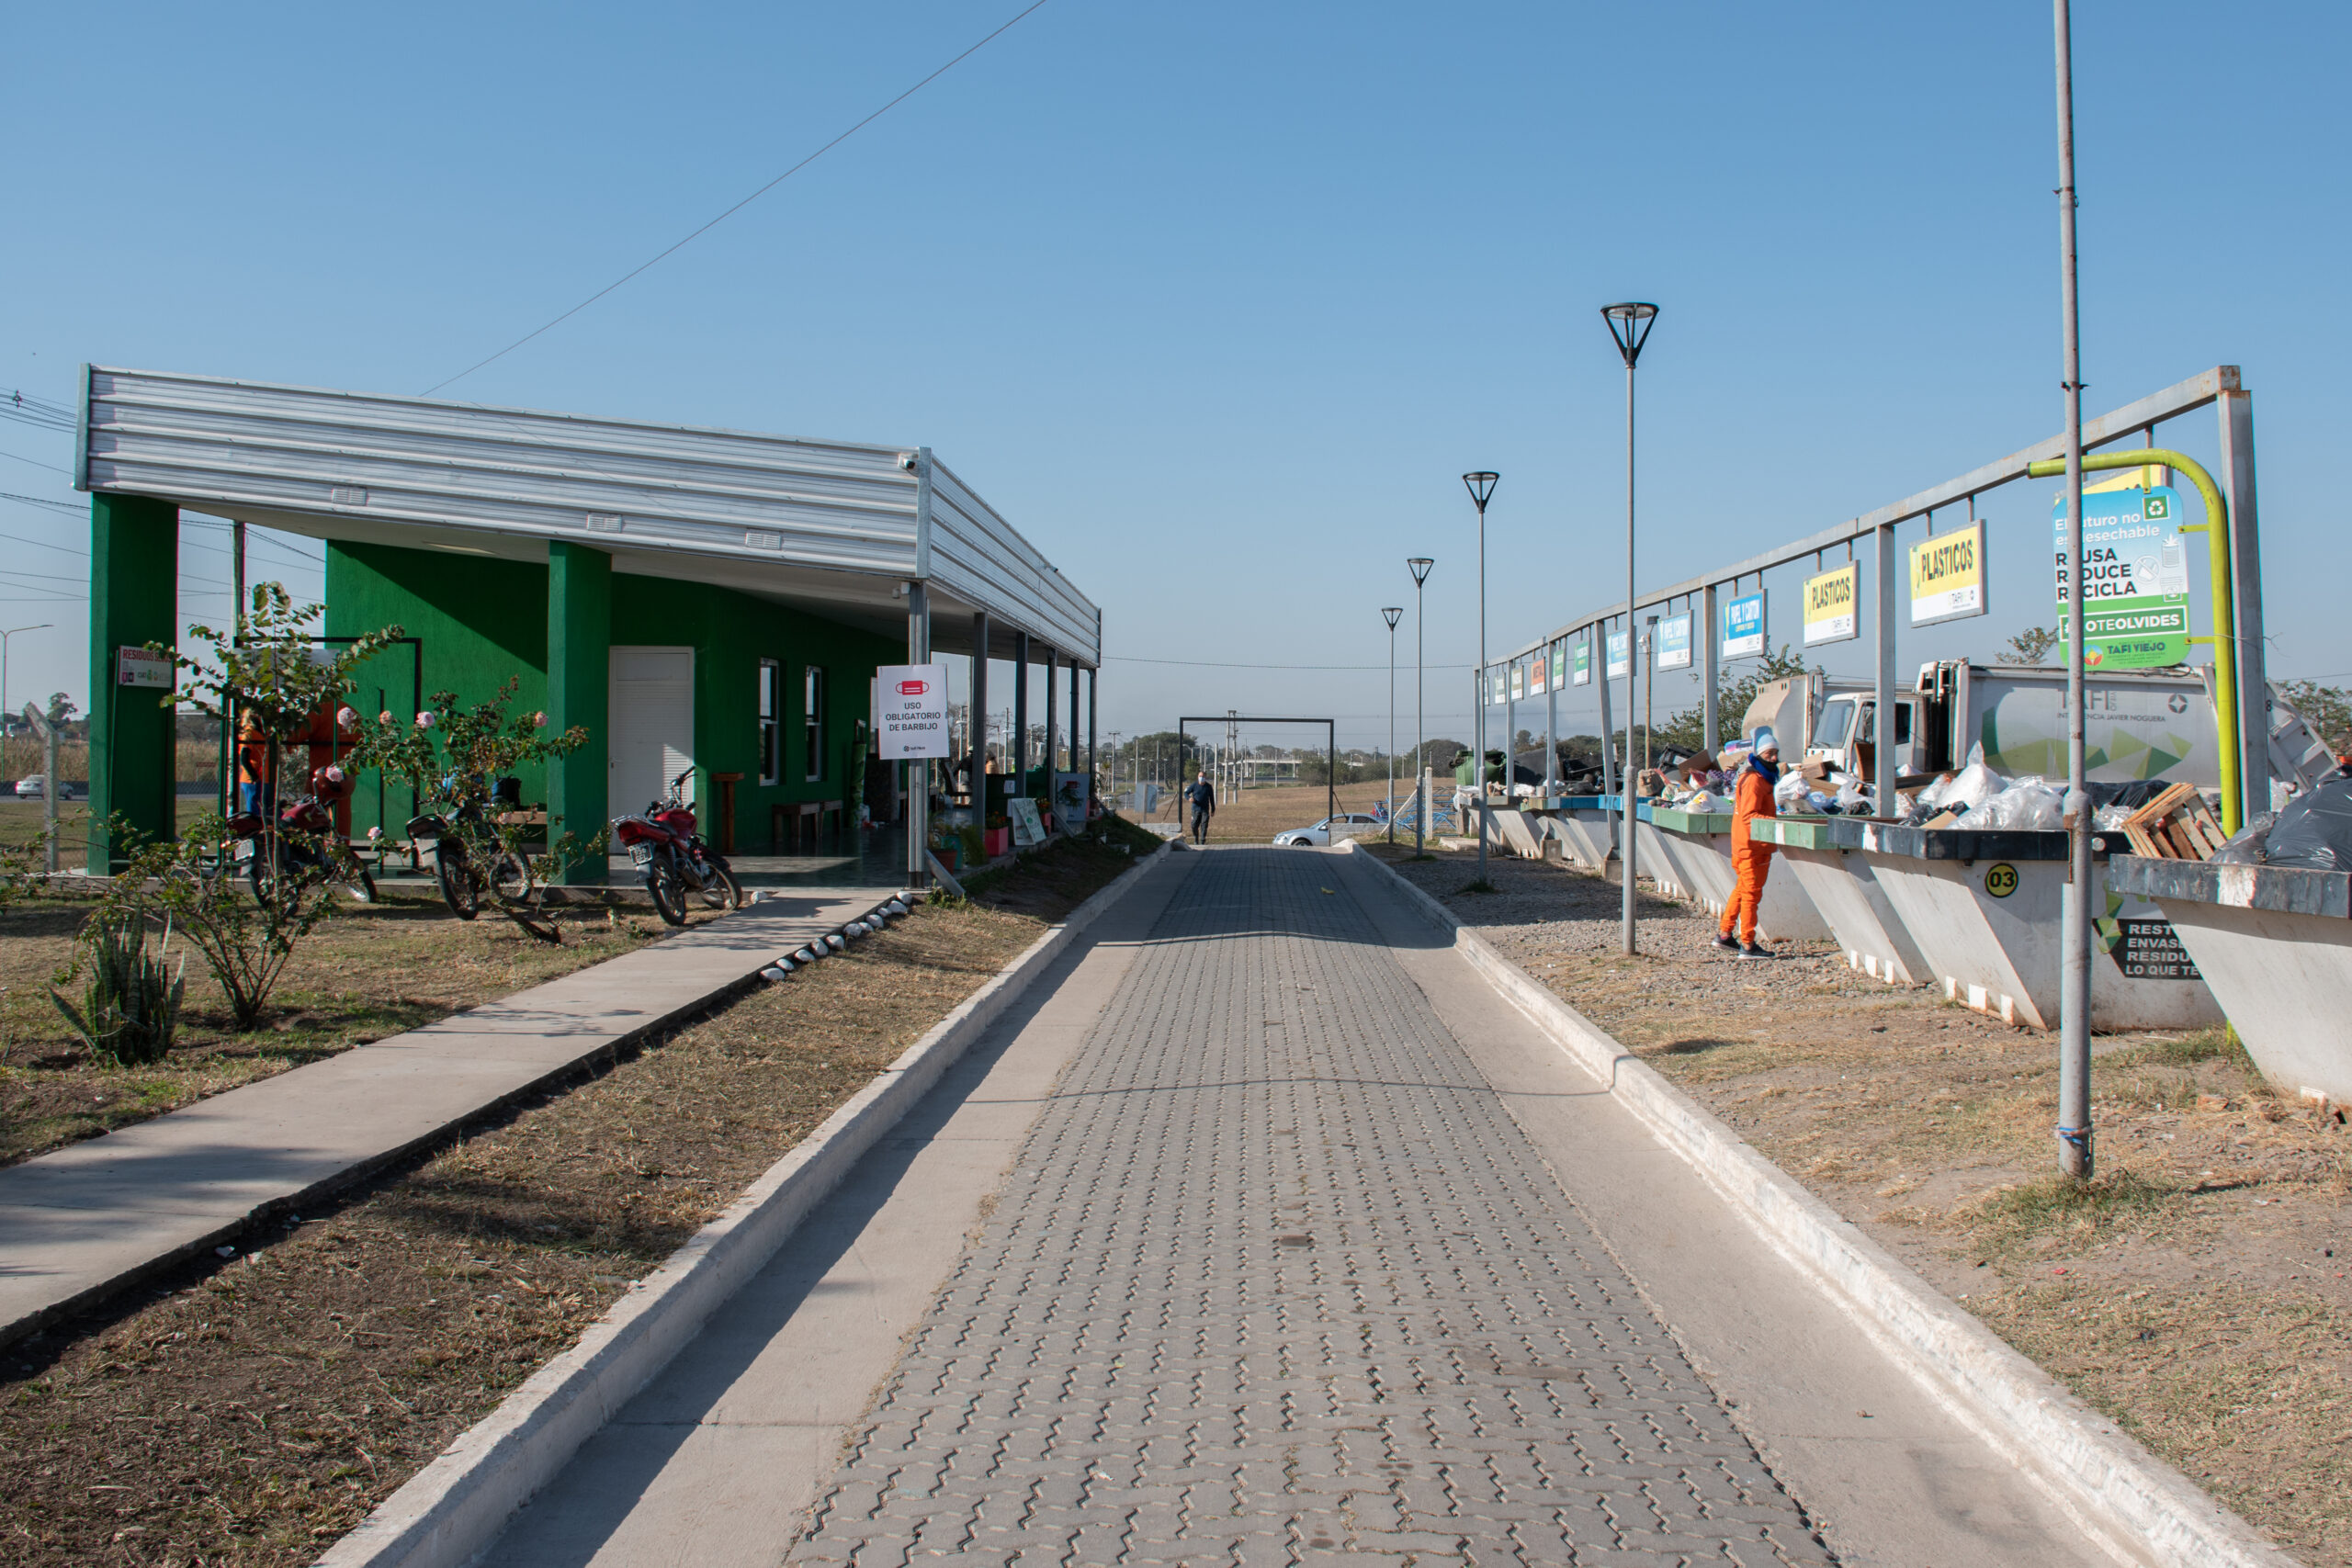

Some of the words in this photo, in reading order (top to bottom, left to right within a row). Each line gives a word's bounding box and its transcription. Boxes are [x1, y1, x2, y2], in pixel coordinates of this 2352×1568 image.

[2055, 517, 2069, 531] El
[2072, 515, 2118, 529] turo
[2122, 513, 2141, 525] no
[2075, 525, 2160, 543] esechable
[1921, 538, 1973, 582] PLASTICOS
[2055, 547, 2118, 566] RUSA
[2056, 563, 2132, 583] RDUCE
[1812, 575, 1850, 611] PLASTICOS
[2057, 581, 2138, 600] RCICLA
[2064, 614, 2180, 634] OTEOLVIDES
[2133, 642, 2165, 652] VIEJO
[904, 702, 922, 710] USO
[2057, 689, 2109, 711] TFI
[885, 712, 942, 721] OBLIGATORIO
[2057, 712, 2105, 720] INTENCIA
[888, 724, 900, 732] DE
[901, 722, 938, 731] BARBIJO
[1989, 871, 2016, 888] 03
[2128, 923, 2173, 935] REST
[2126, 951, 2191, 963] RESIDU
[2125, 964, 2145, 976] LO
[2148, 964, 2177, 976] QUE
